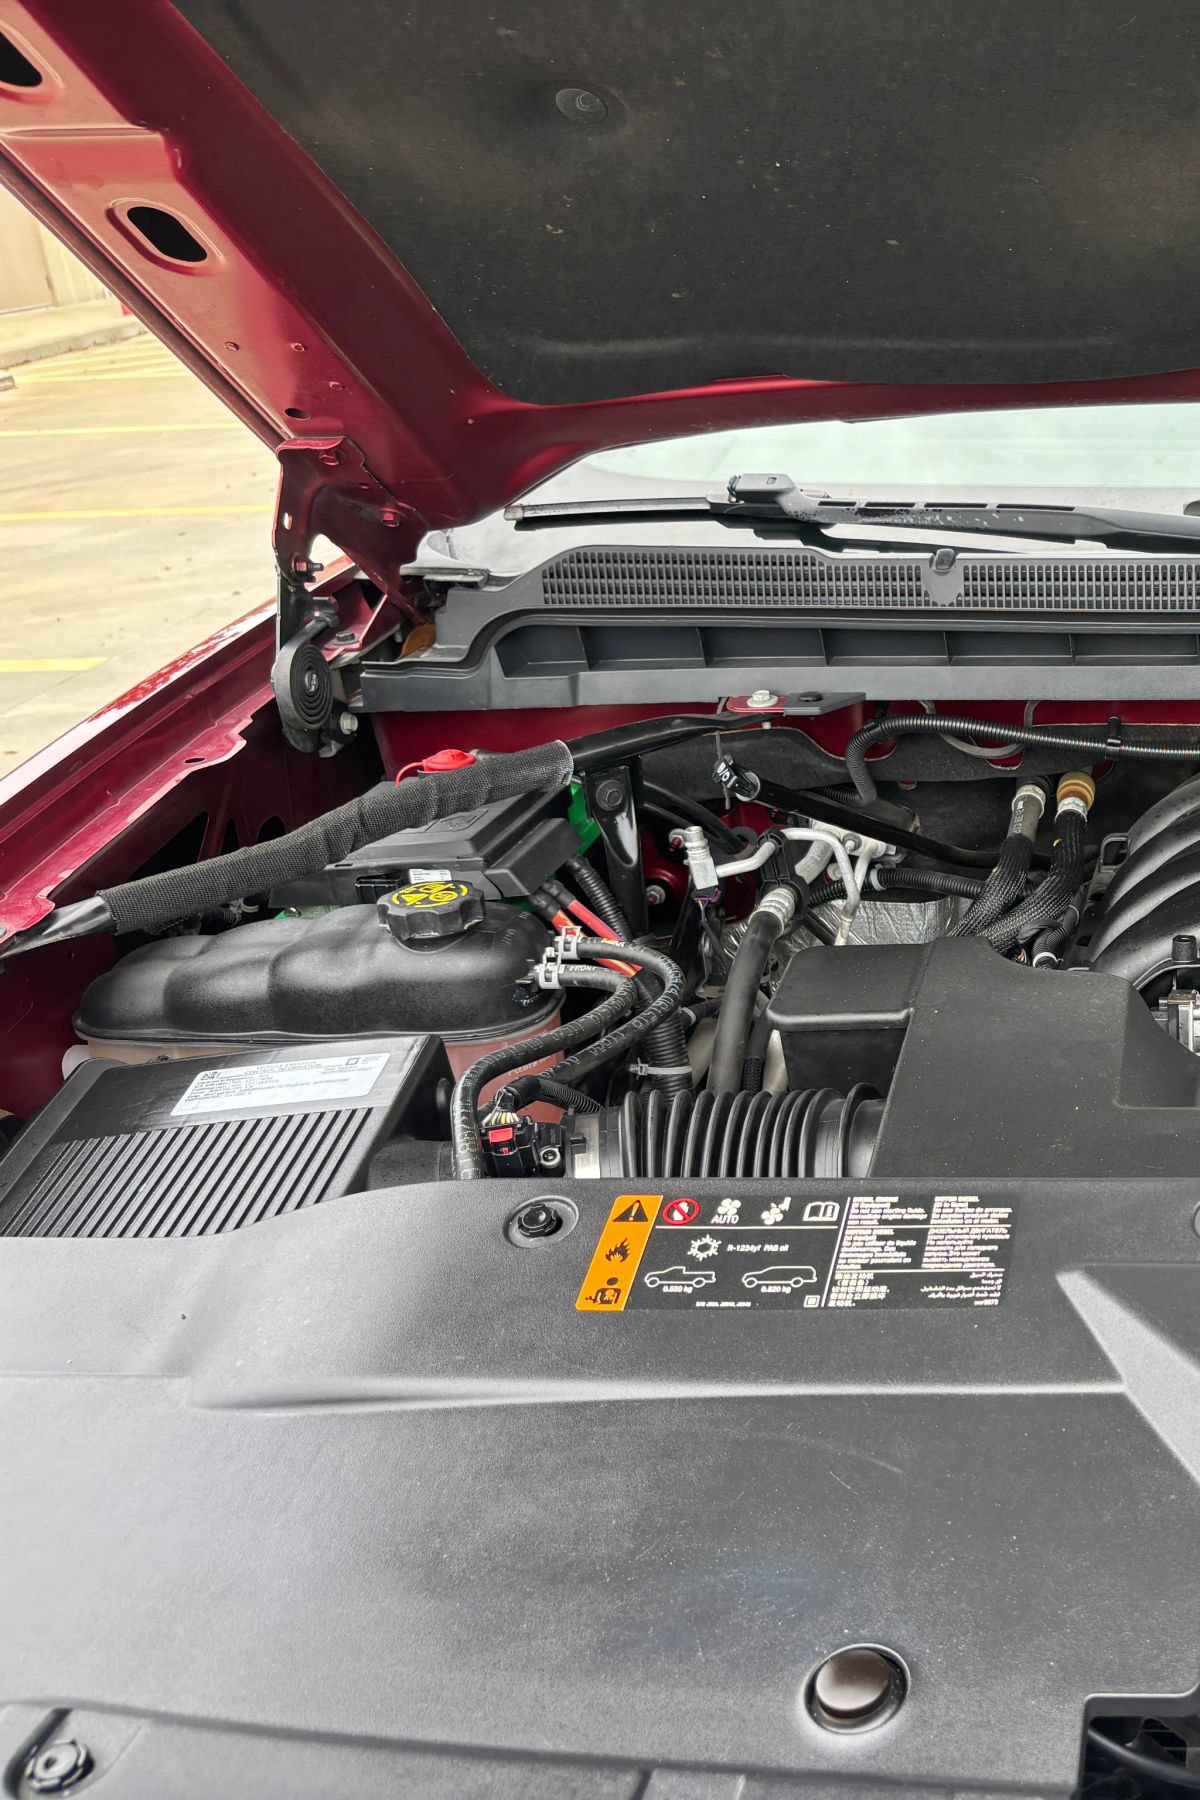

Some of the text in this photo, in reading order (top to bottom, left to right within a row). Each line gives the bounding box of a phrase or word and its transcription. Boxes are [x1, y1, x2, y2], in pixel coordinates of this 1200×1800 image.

[711, 1214, 740, 1224] AUTO
[727, 1244, 762, 1253] R-1234yf
[779, 1244, 789, 1252] oil
[683, 1285, 693, 1294] kg
[782, 1285, 792, 1294] kg
